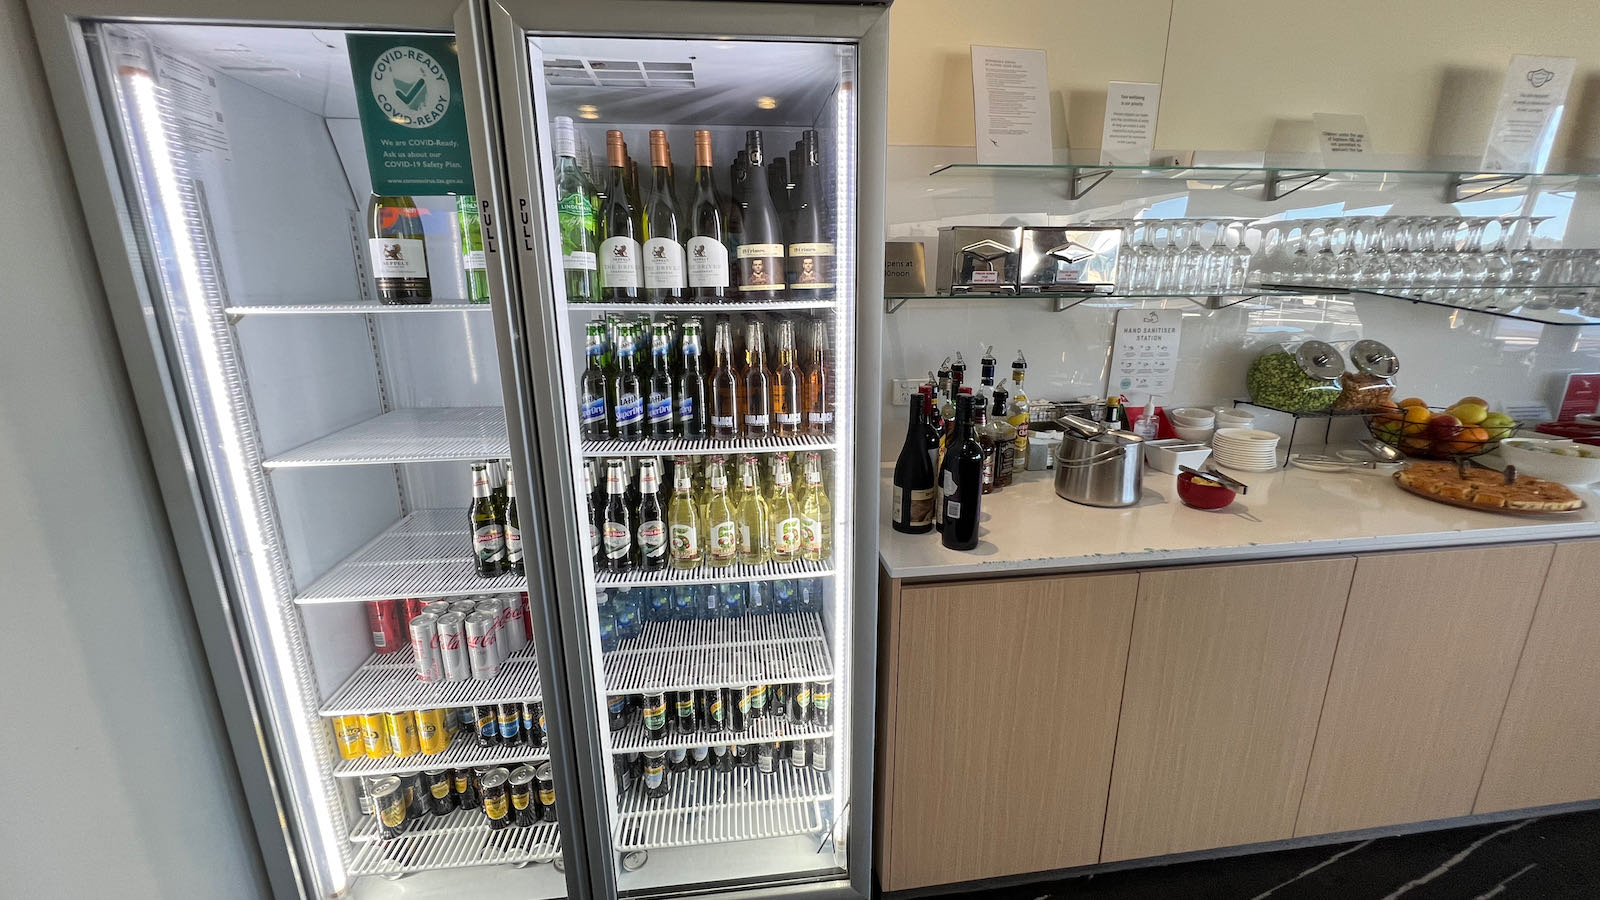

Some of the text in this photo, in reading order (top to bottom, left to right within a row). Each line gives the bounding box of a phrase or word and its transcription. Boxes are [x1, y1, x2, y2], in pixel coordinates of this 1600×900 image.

[374, 49, 446, 82] COVID-READY
[377, 94, 448, 126] COVID-READY
[384, 160, 421, 168] COVID-19
[422, 160, 443, 169] Safety
[482, 200, 496, 253] PULL
[519, 198, 533, 251] PULL
[583, 405, 605, 418] perDry
